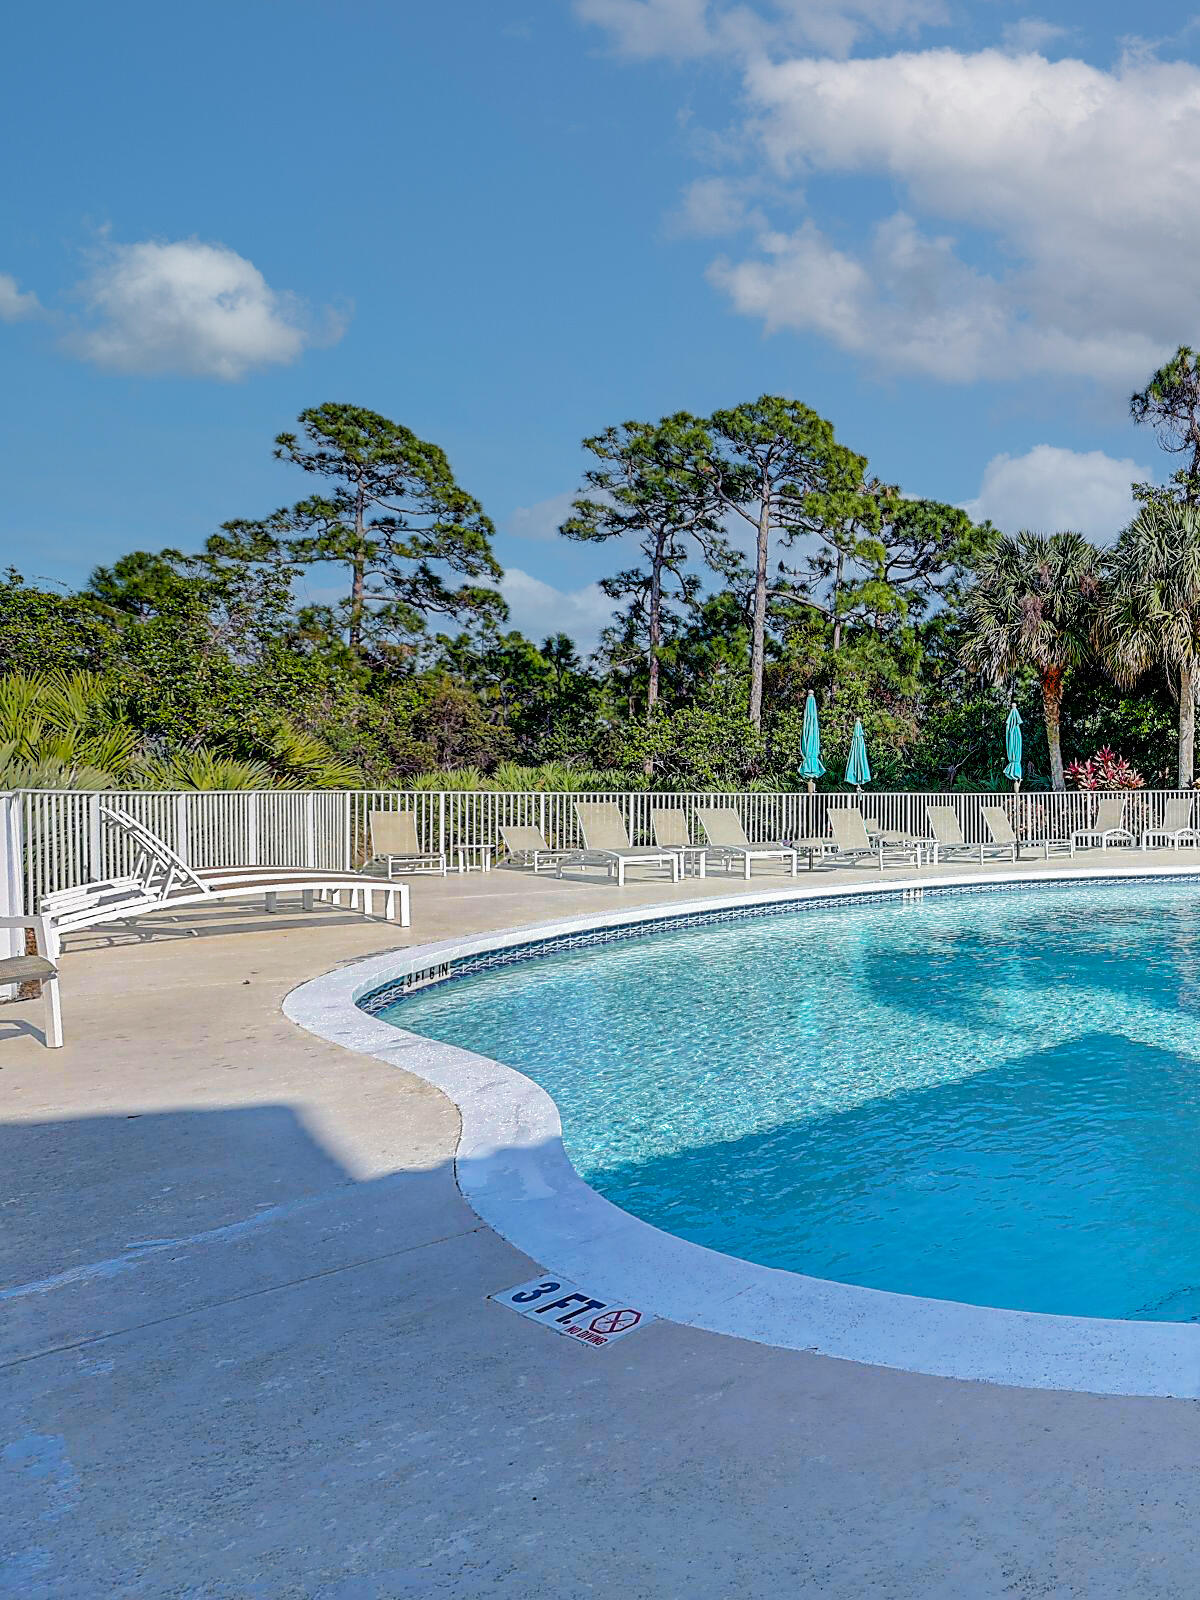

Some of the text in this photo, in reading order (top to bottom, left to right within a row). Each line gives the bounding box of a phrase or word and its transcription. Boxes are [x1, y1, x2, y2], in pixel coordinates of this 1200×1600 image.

[913, 888, 922, 897] FT
[406, 961, 449, 988] 3 FT 6 IN
[511, 1281, 608, 1325] 3 FT.
[564, 1325, 609, 1346] NO DIVING
